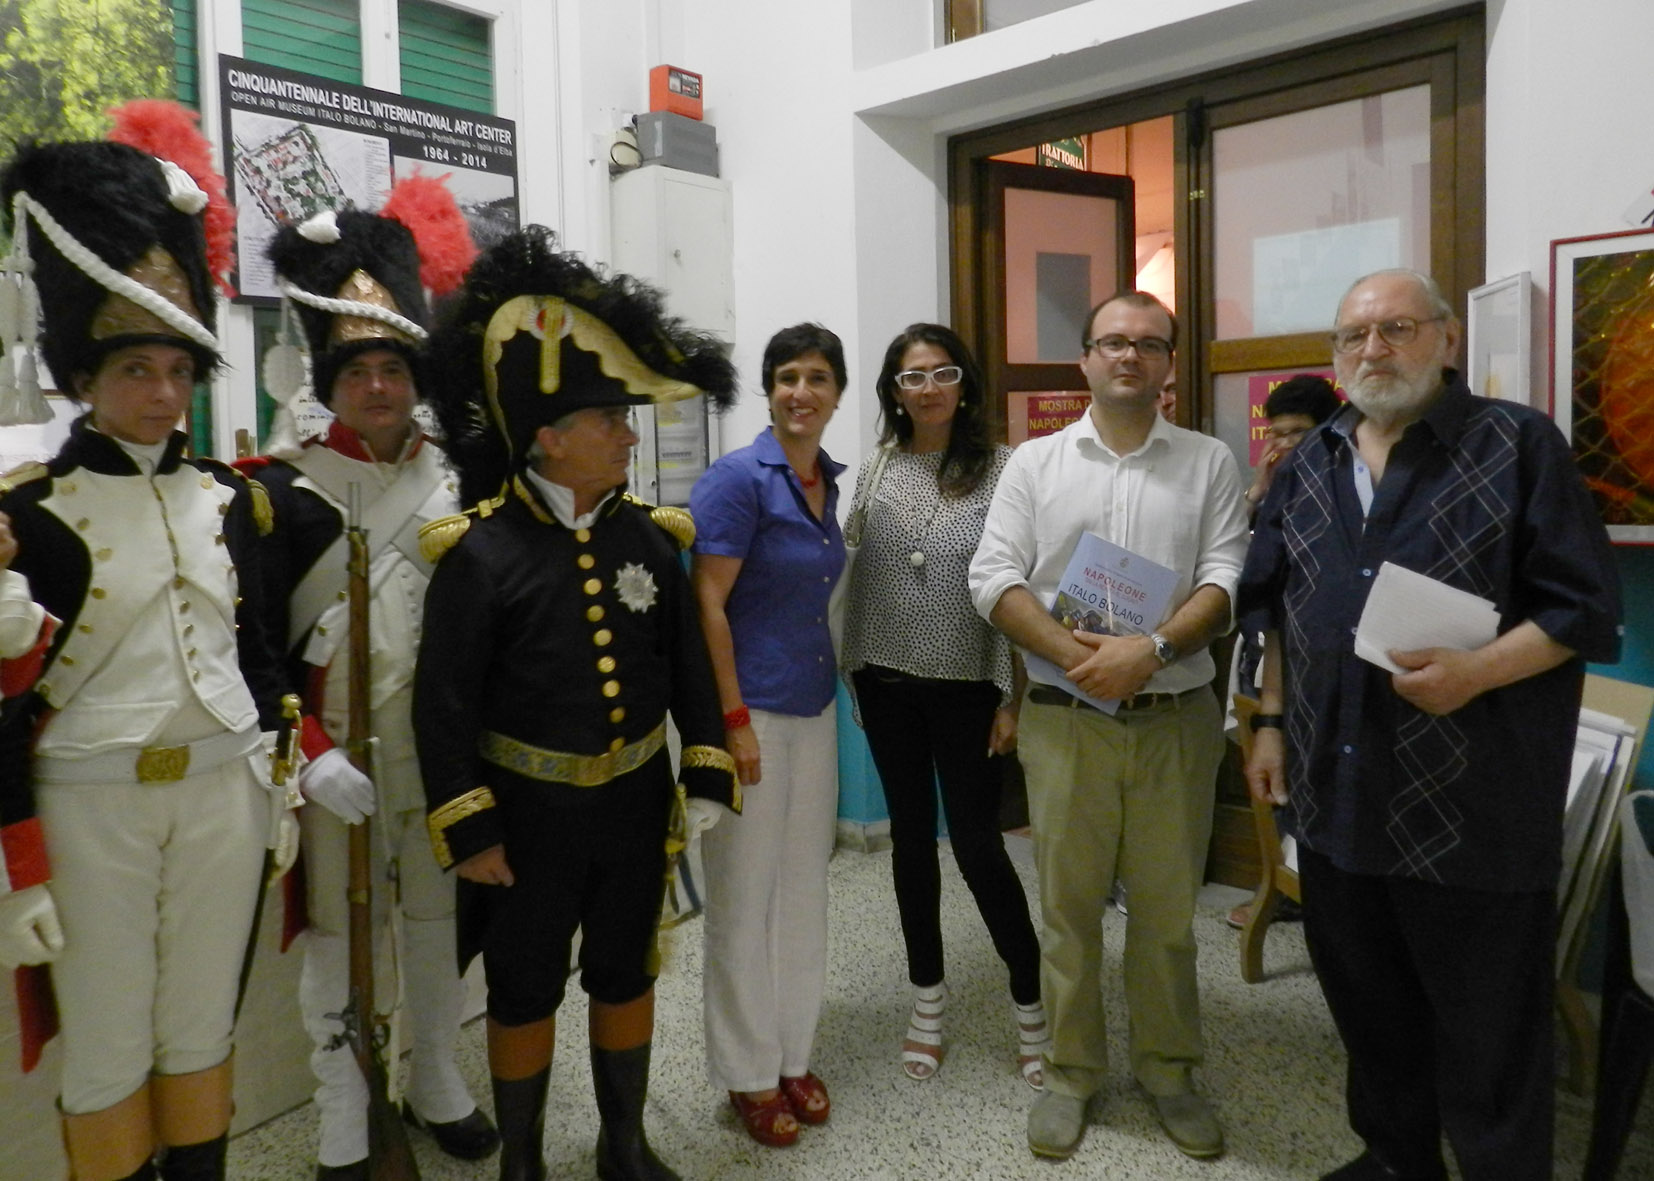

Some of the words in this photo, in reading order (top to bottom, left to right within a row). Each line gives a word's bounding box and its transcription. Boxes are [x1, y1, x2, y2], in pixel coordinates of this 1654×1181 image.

[228, 69, 341, 109] CINQUANTENNALE
[342, 94, 453, 133] DELL'INTERNATIONAL
[454, 120, 474, 137] ART
[475, 123, 513, 146] CENTER
[231, 91, 258, 106] OPEN
[260, 97, 276, 109] AIR
[278, 100, 316, 117] MUSEUM
[317, 108, 342, 123] ITALO
[344, 114, 377, 130] BOLANO
[383, 122, 398, 133] San
[400, 124, 426, 140] Martino
[432, 131, 472, 149] Portoferraio
[422, 145, 450, 162] 1964
[461, 152, 488, 169] 2014
[1041, 142, 1084, 171] TRATTORIA
[1038, 399, 1083, 412] MOSTRA
[1028, 417, 1079, 431] NAPOLE
[1083, 566, 1147, 602] NAPOLEONE
[1068, 583, 1098, 604] ITALO
[1098, 598, 1144, 626] BOLANO
